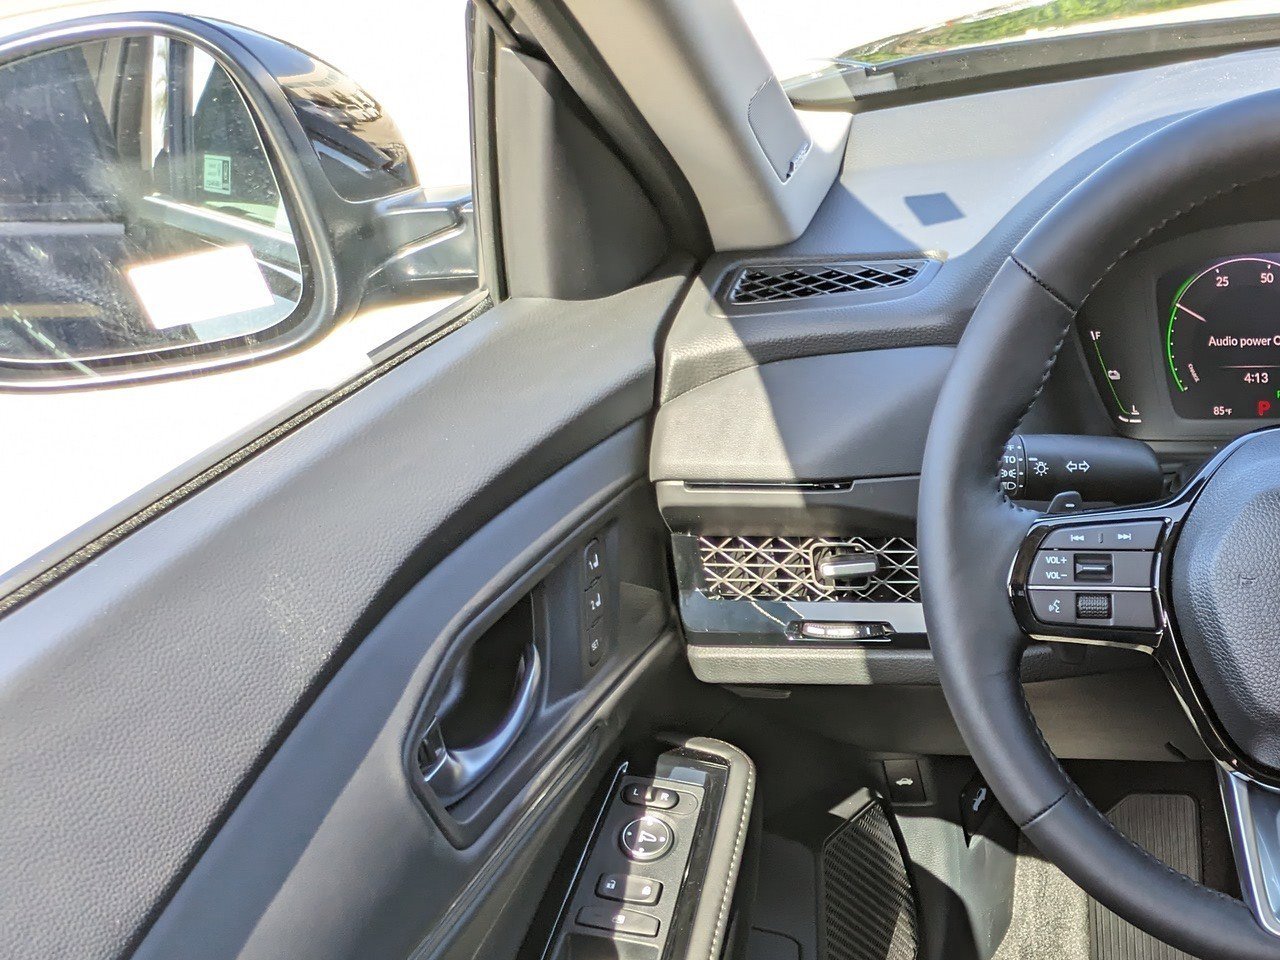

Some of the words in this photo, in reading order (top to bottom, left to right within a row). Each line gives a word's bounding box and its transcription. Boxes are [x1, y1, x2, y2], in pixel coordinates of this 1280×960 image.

[1216, 276, 1230, 287] 25
[1260, 272, 1274, 284] 50
[1208, 334, 1239, 347] Audio
[1239, 337, 1273, 349] power
[1243, 372, 1269, 384] 4:13
[1258, 400, 1271, 416] P
[1045, 556, 1067, 565] VOL+
